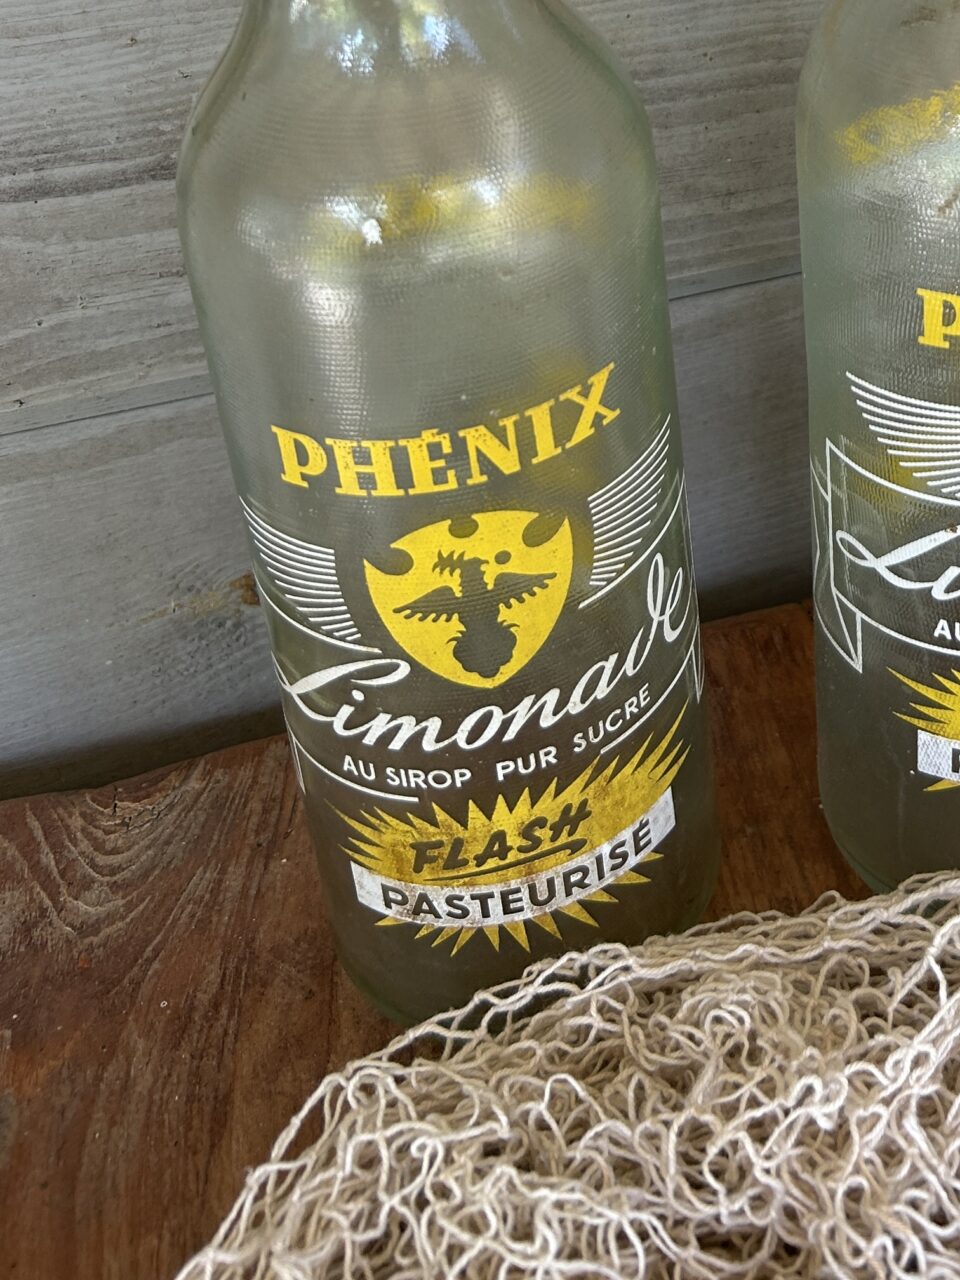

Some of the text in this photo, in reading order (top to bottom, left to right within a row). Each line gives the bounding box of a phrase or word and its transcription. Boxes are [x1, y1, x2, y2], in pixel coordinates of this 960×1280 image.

[270, 361, 622, 498] PHÉNIX
[271, 552, 692, 752] Limonade
[342, 682, 651, 790] AU SIROP PUR SUCRE
[380, 816, 653, 922] PASTEURISÉ
[410, 802, 592, 875] FLASH
